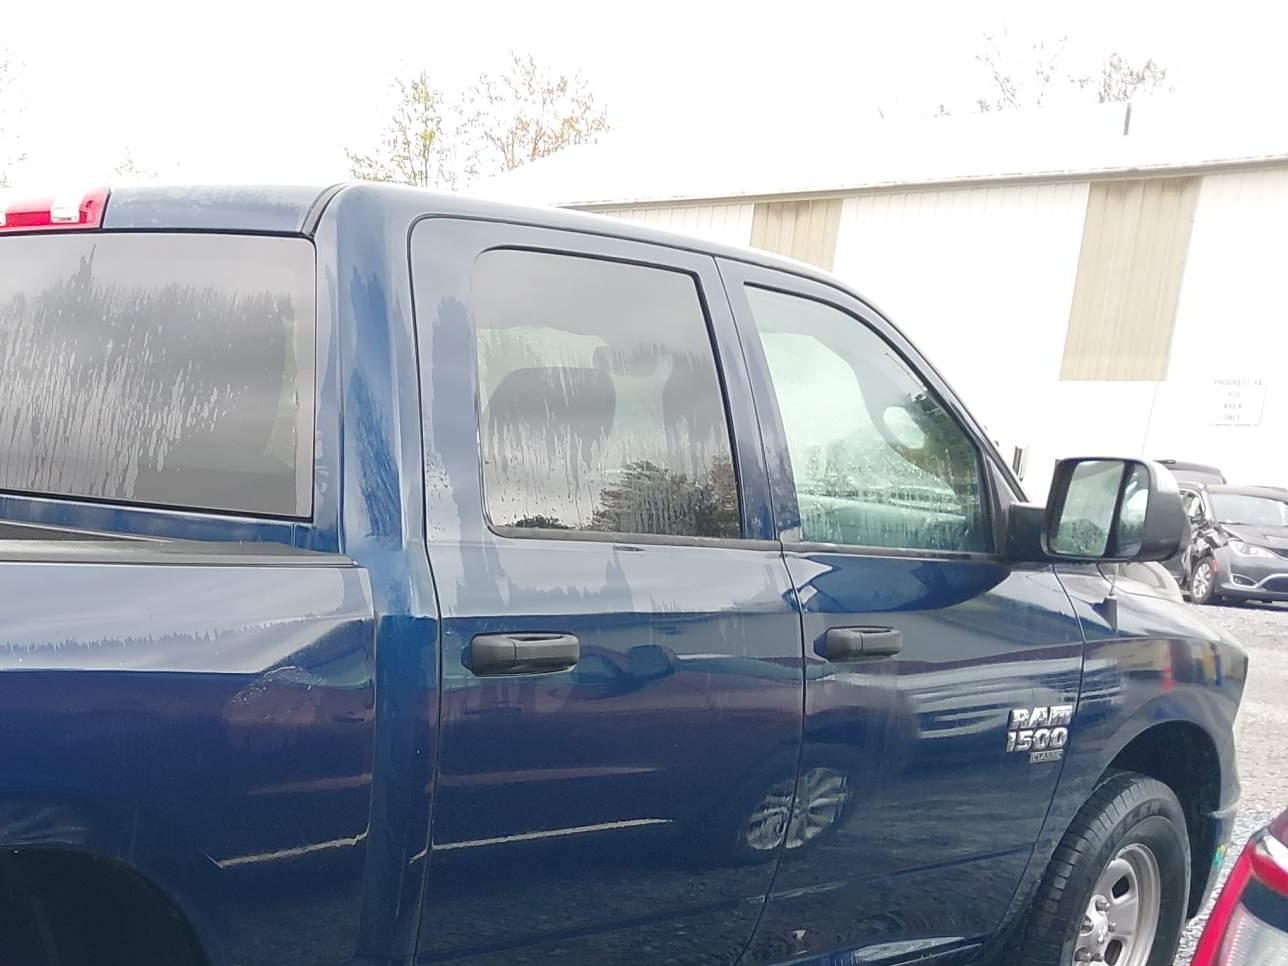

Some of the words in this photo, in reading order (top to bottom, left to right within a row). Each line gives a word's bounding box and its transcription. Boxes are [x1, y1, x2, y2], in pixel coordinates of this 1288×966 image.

[1214, 376, 1263, 387] PROGREVE
[1009, 705, 1073, 729] RAM
[1006, 727, 1069, 753] 1500
